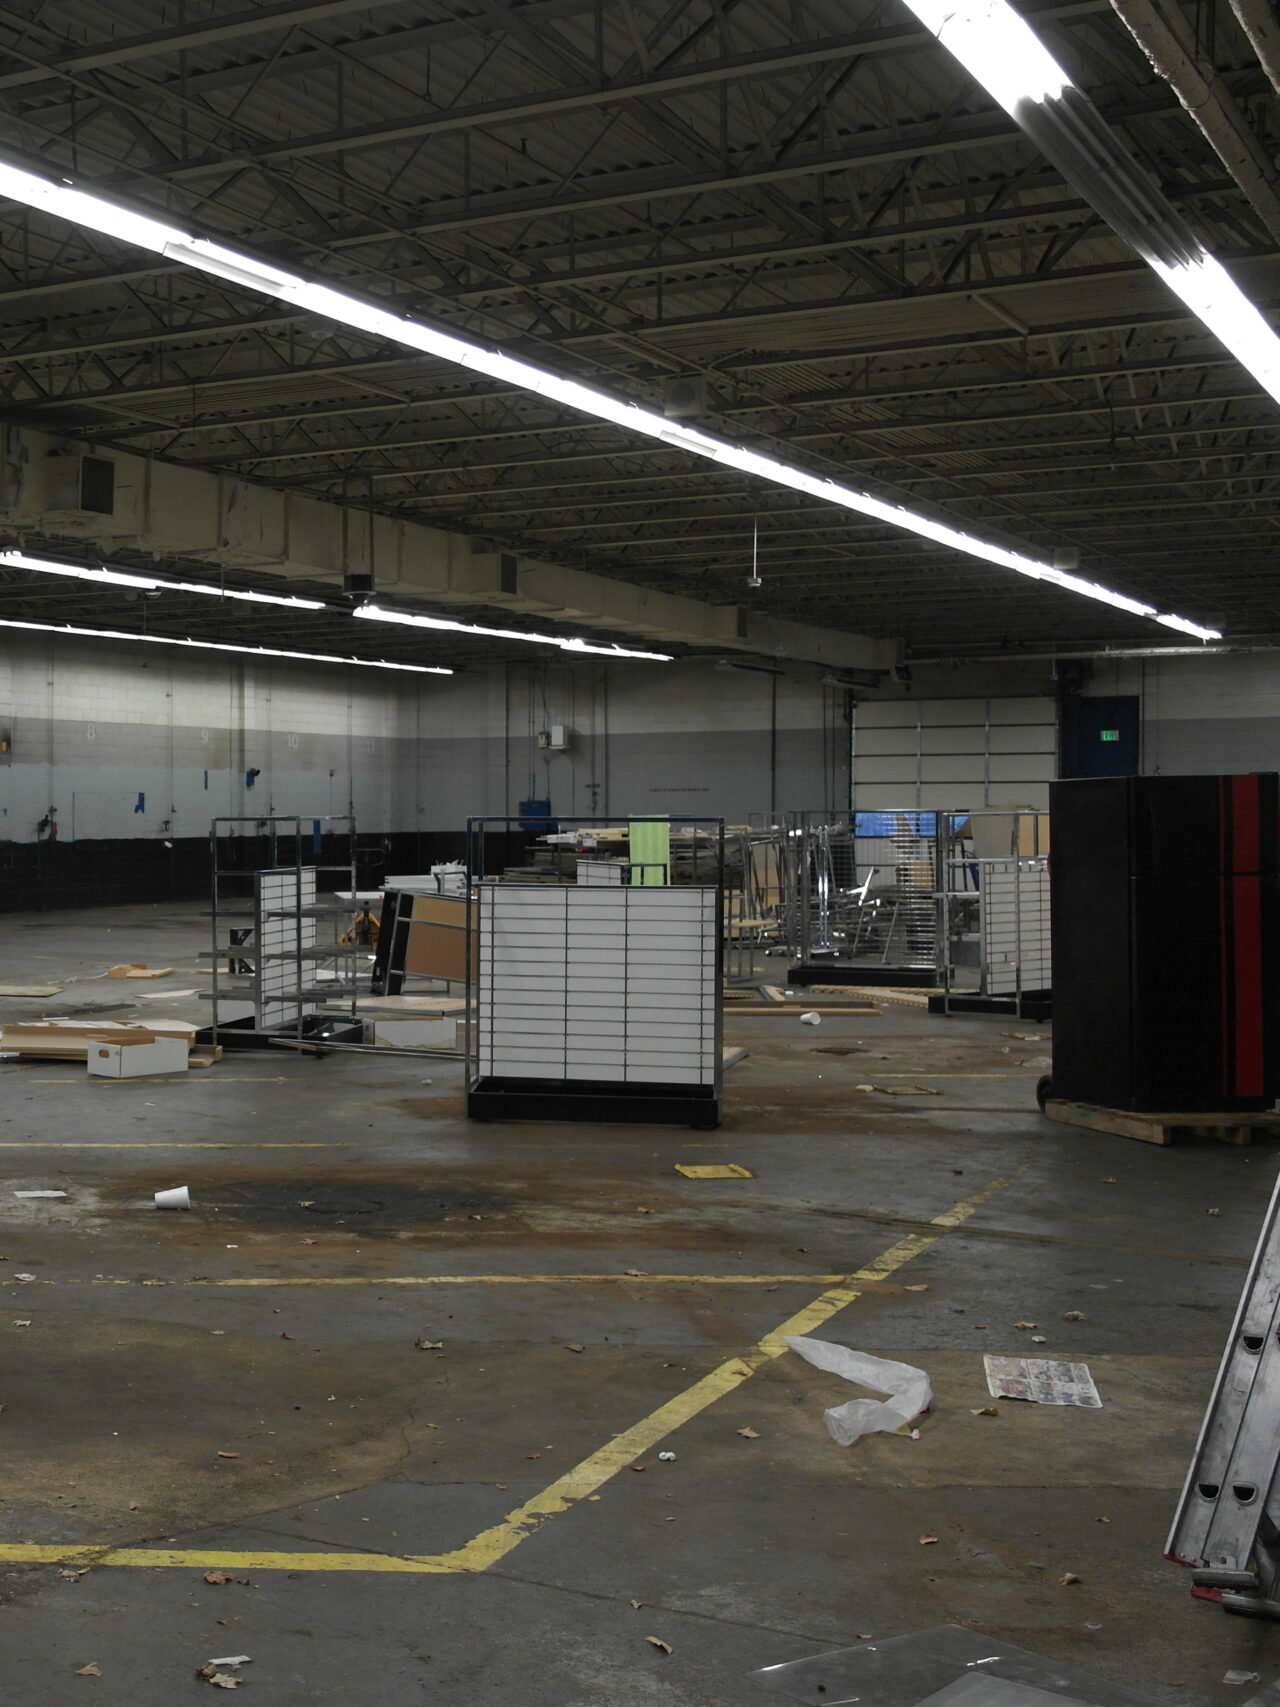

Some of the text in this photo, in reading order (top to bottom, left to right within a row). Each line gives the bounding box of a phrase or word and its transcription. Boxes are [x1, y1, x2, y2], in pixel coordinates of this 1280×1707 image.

[87, 722, 96, 740] 8
[201, 728, 209, 744] 9
[287, 733, 299, 750] 10
